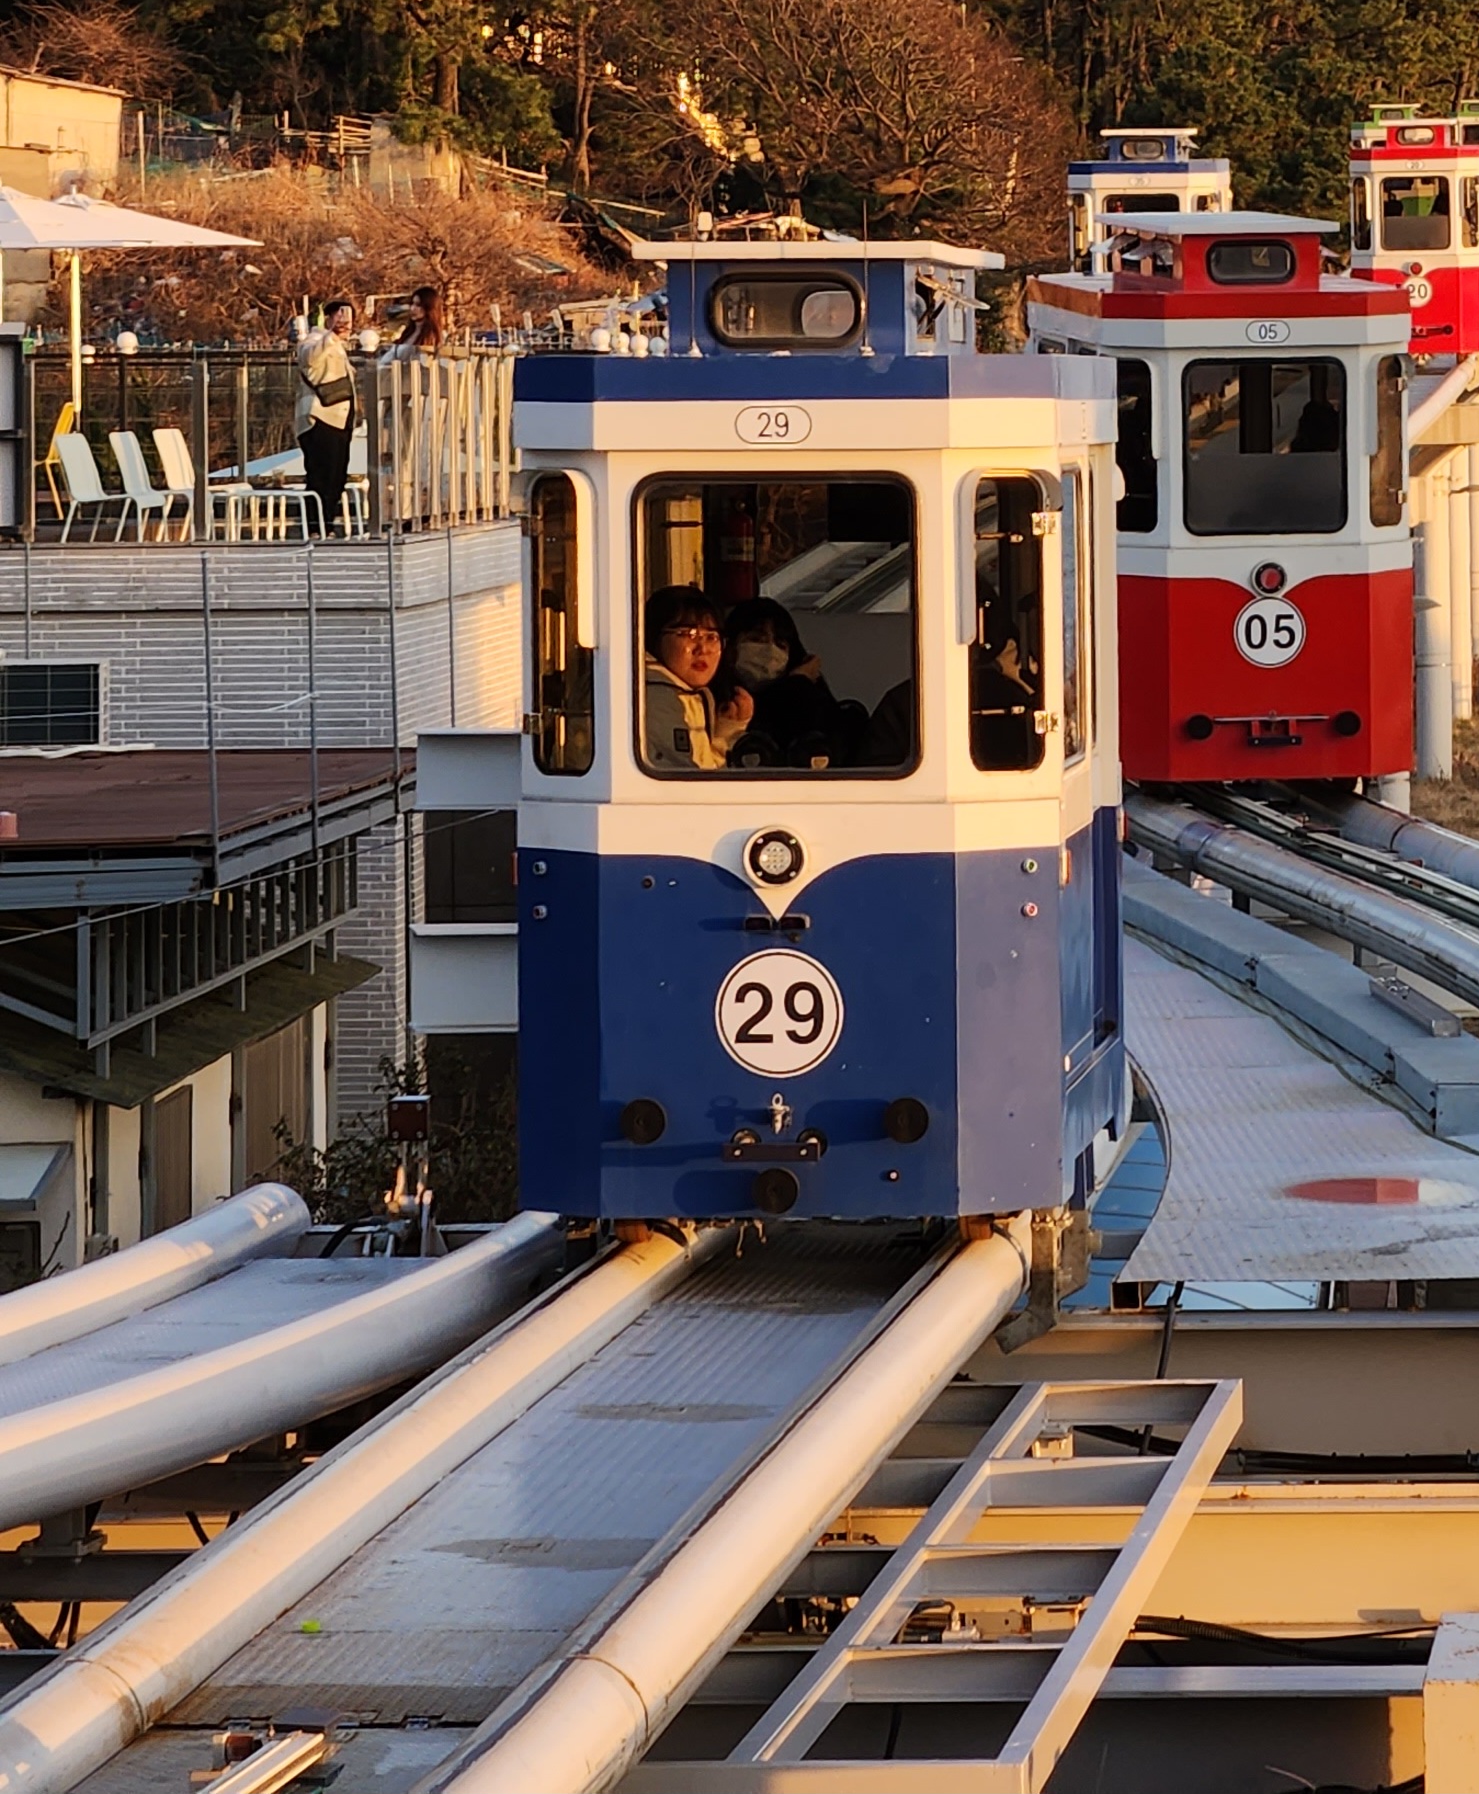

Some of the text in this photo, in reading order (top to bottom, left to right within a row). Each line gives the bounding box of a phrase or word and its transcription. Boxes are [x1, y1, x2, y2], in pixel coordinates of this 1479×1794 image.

[1406, 283, 1428, 299] 20
[1258, 323, 1278, 340] 05
[757, 412, 789, 438] 29
[1245, 613, 1296, 650] 05
[734, 981, 824, 1045] 29
